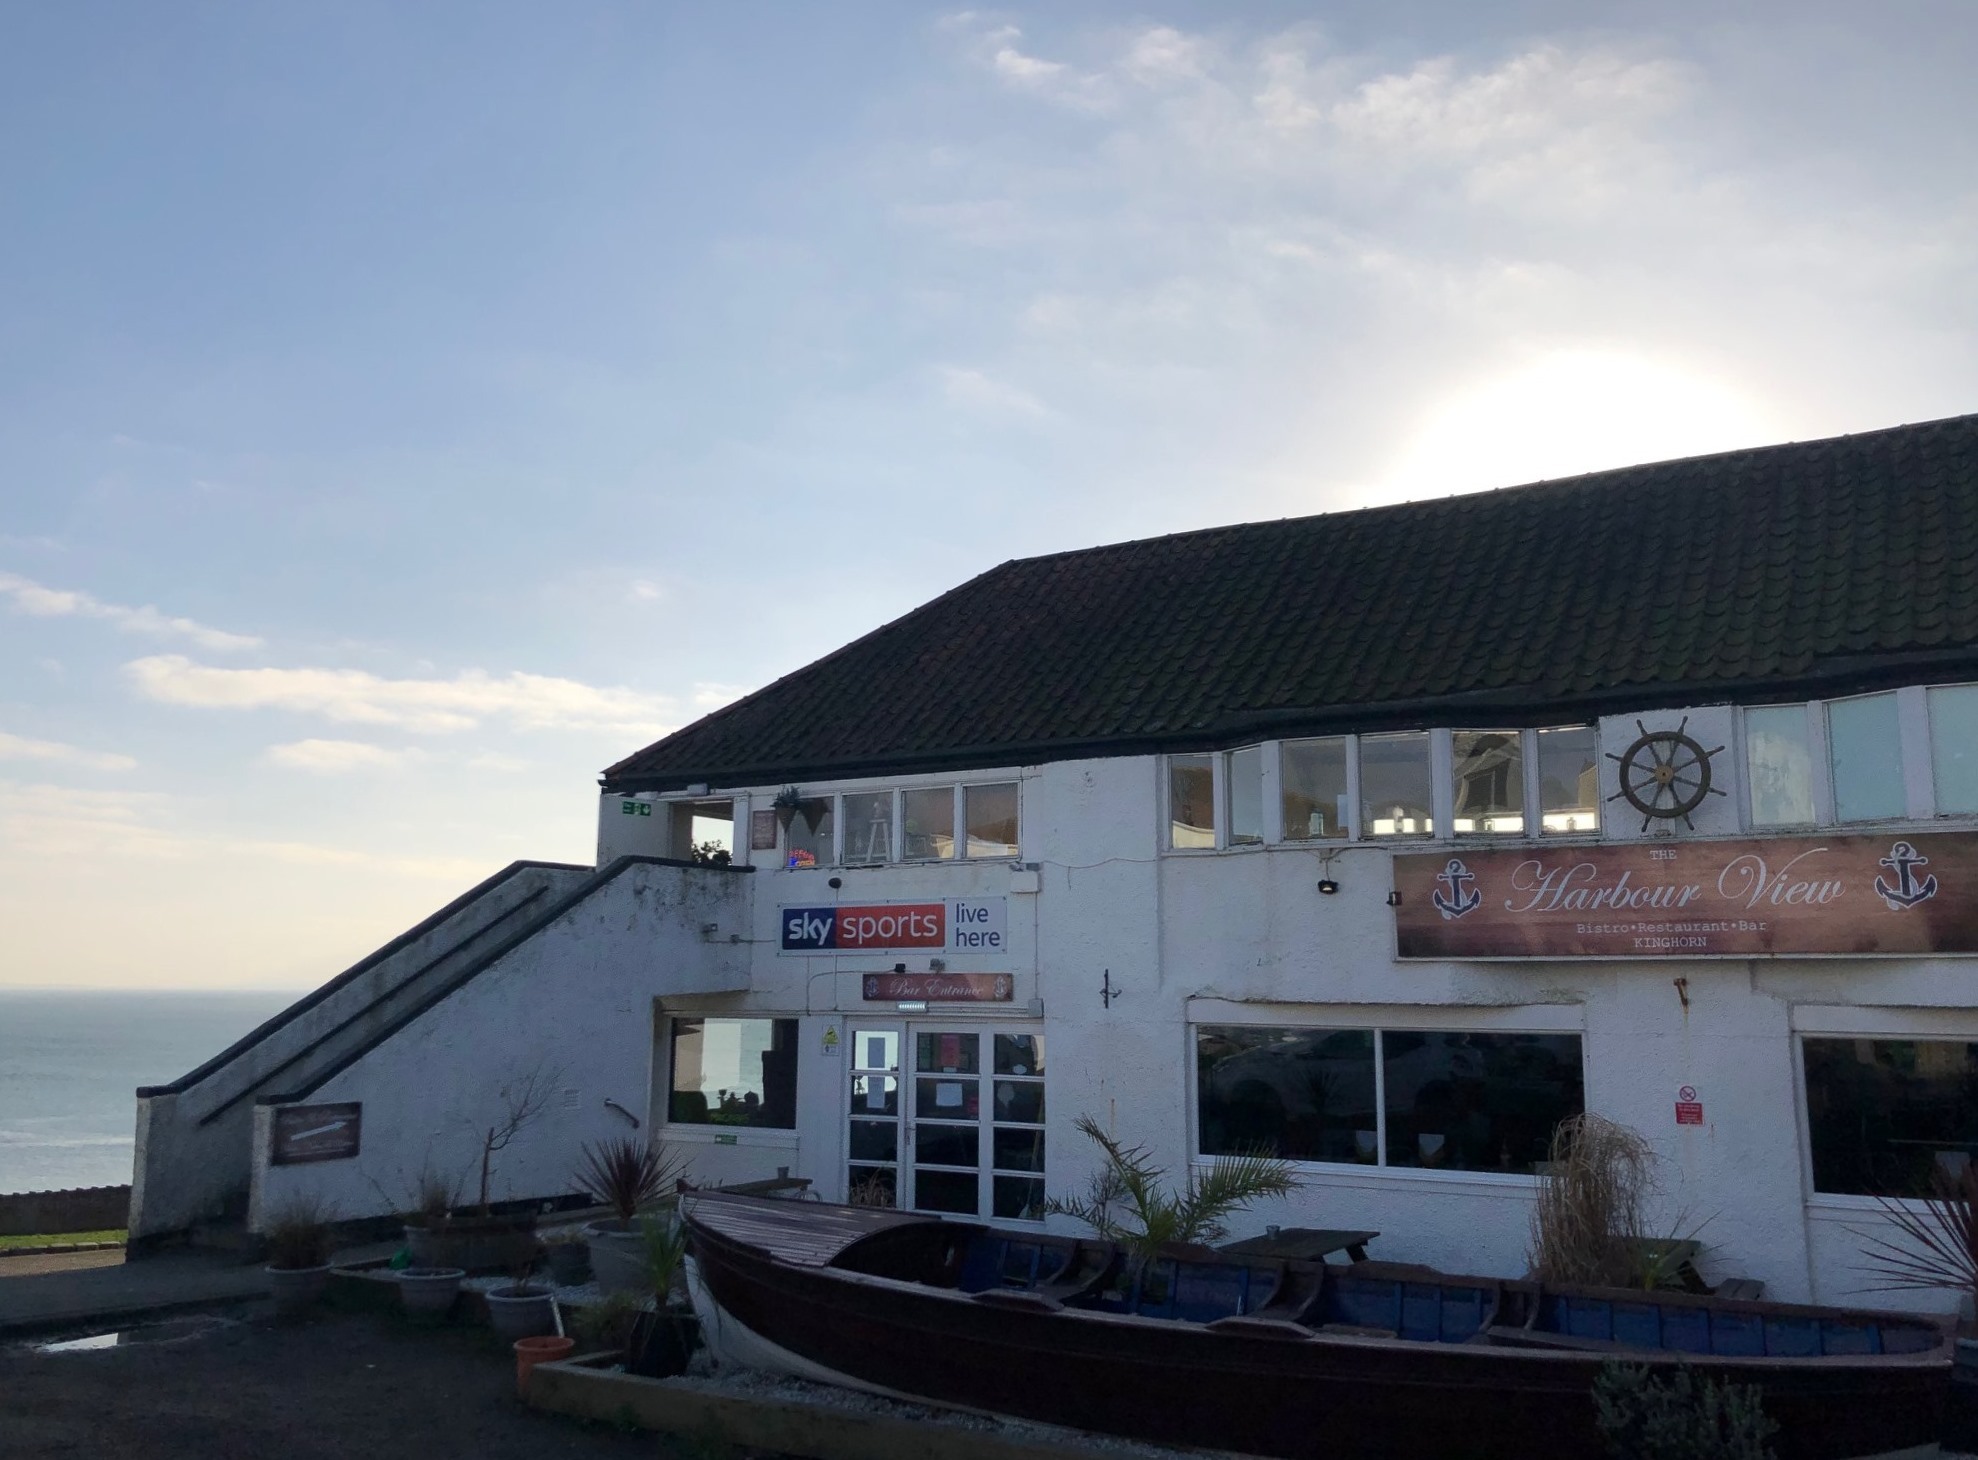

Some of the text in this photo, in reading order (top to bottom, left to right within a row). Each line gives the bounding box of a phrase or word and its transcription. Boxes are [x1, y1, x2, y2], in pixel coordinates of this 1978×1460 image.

[1649, 849, 1678, 861] THE
[1504, 847, 1846, 913] Harbour View
[955, 903, 988, 924] live
[788, 911, 938, 946] sky sports
[1576, 919, 1768, 935] Bistro Restaurant Bar
[955, 927, 1001, 948] here
[1633, 936, 1708, 948] KINGHORN
[889, 978, 985, 996] Bar Entrance
